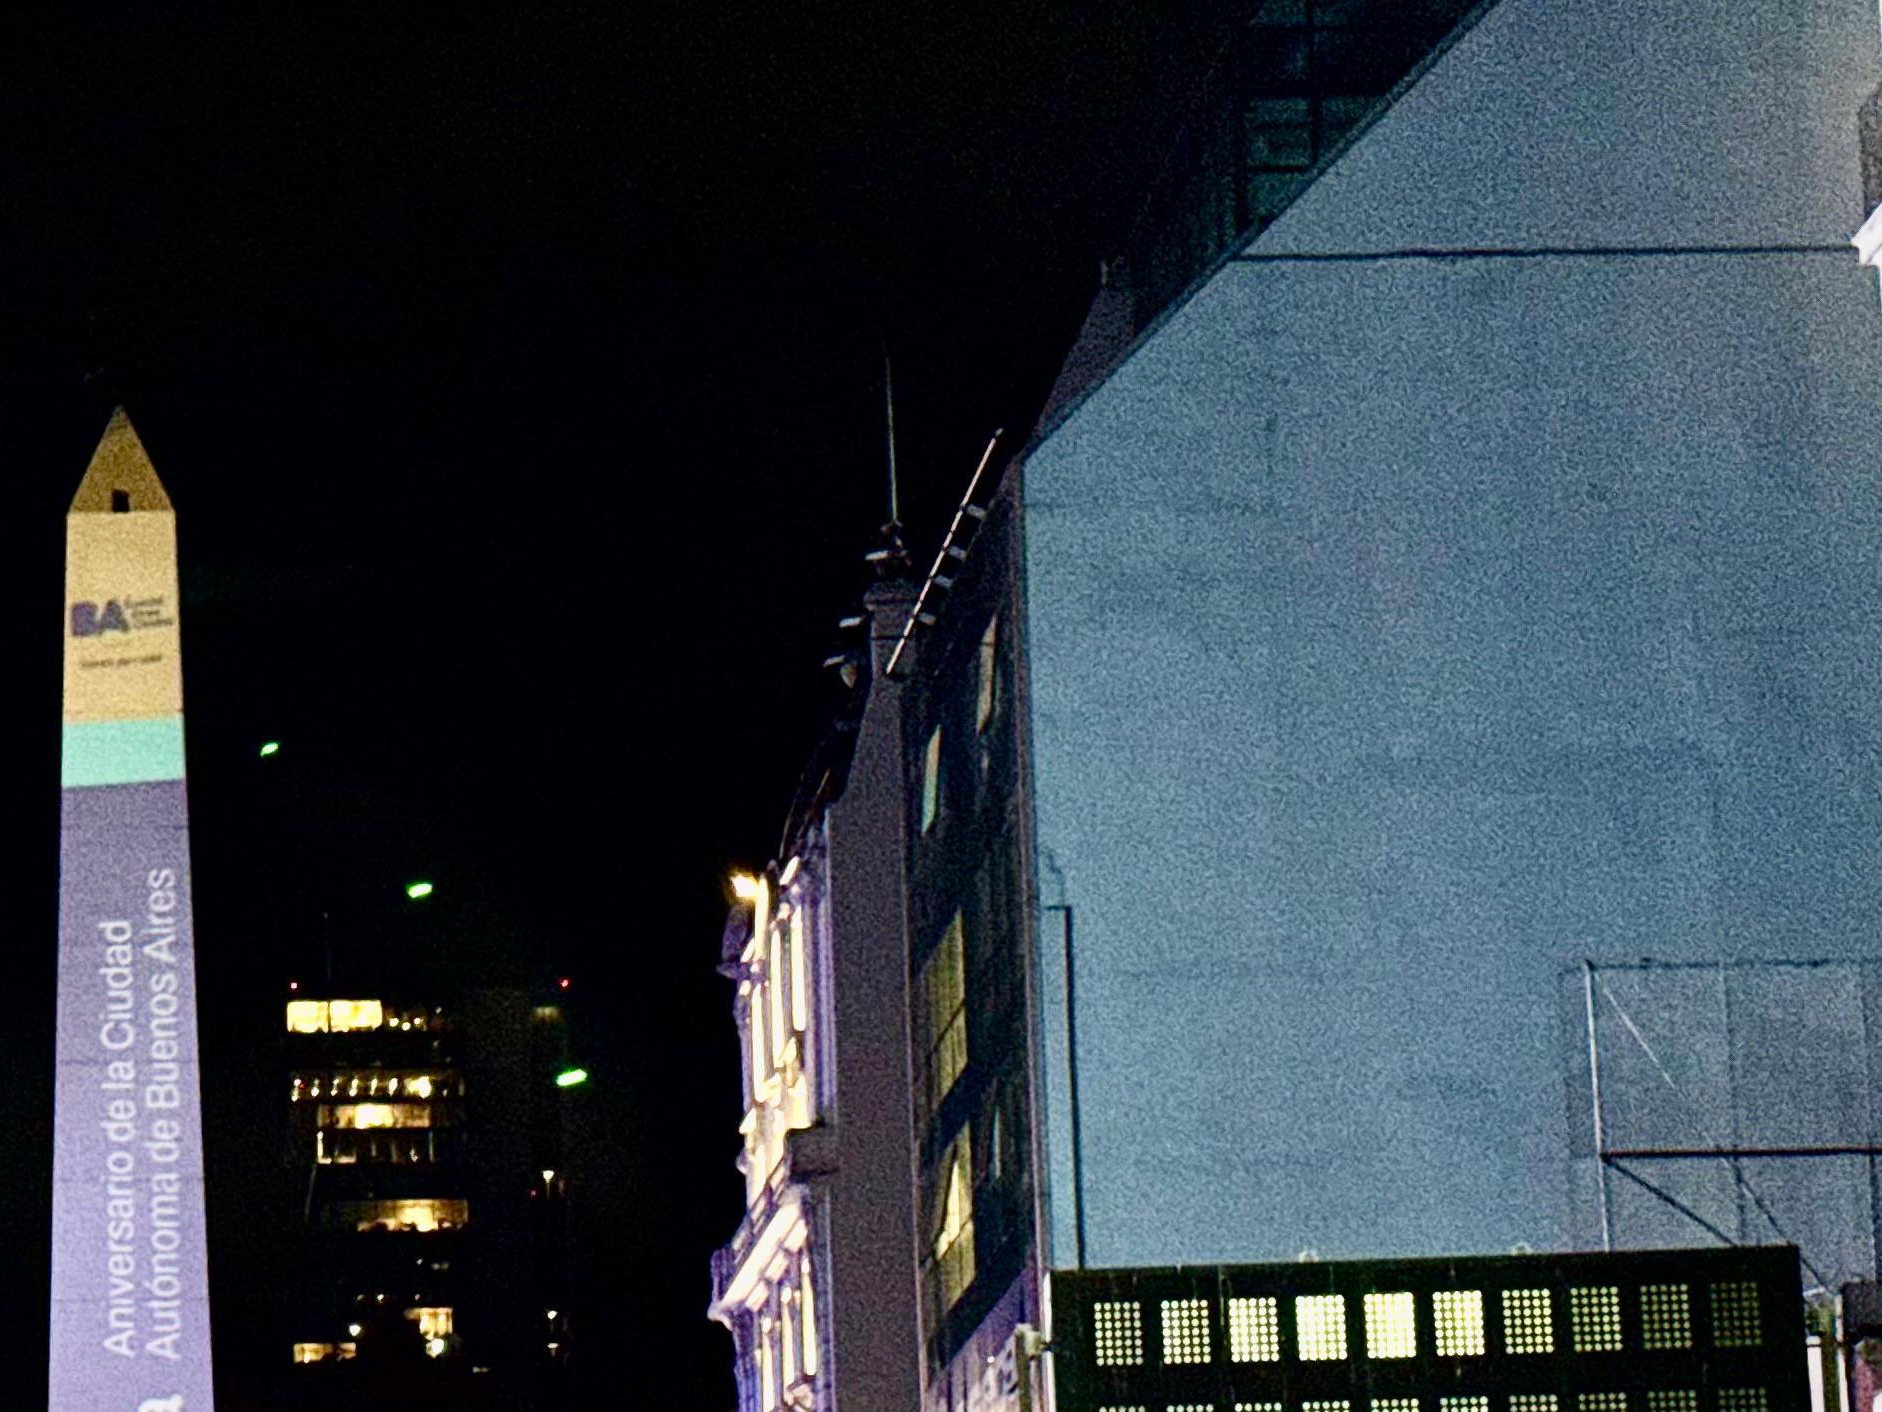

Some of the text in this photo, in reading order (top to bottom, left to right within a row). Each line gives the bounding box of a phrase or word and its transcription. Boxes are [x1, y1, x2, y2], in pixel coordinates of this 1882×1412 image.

[99, 919, 136, 1358] Aniversario de la Ciudad
[143, 867, 182, 1360] Autónoma de Buenos Aires
